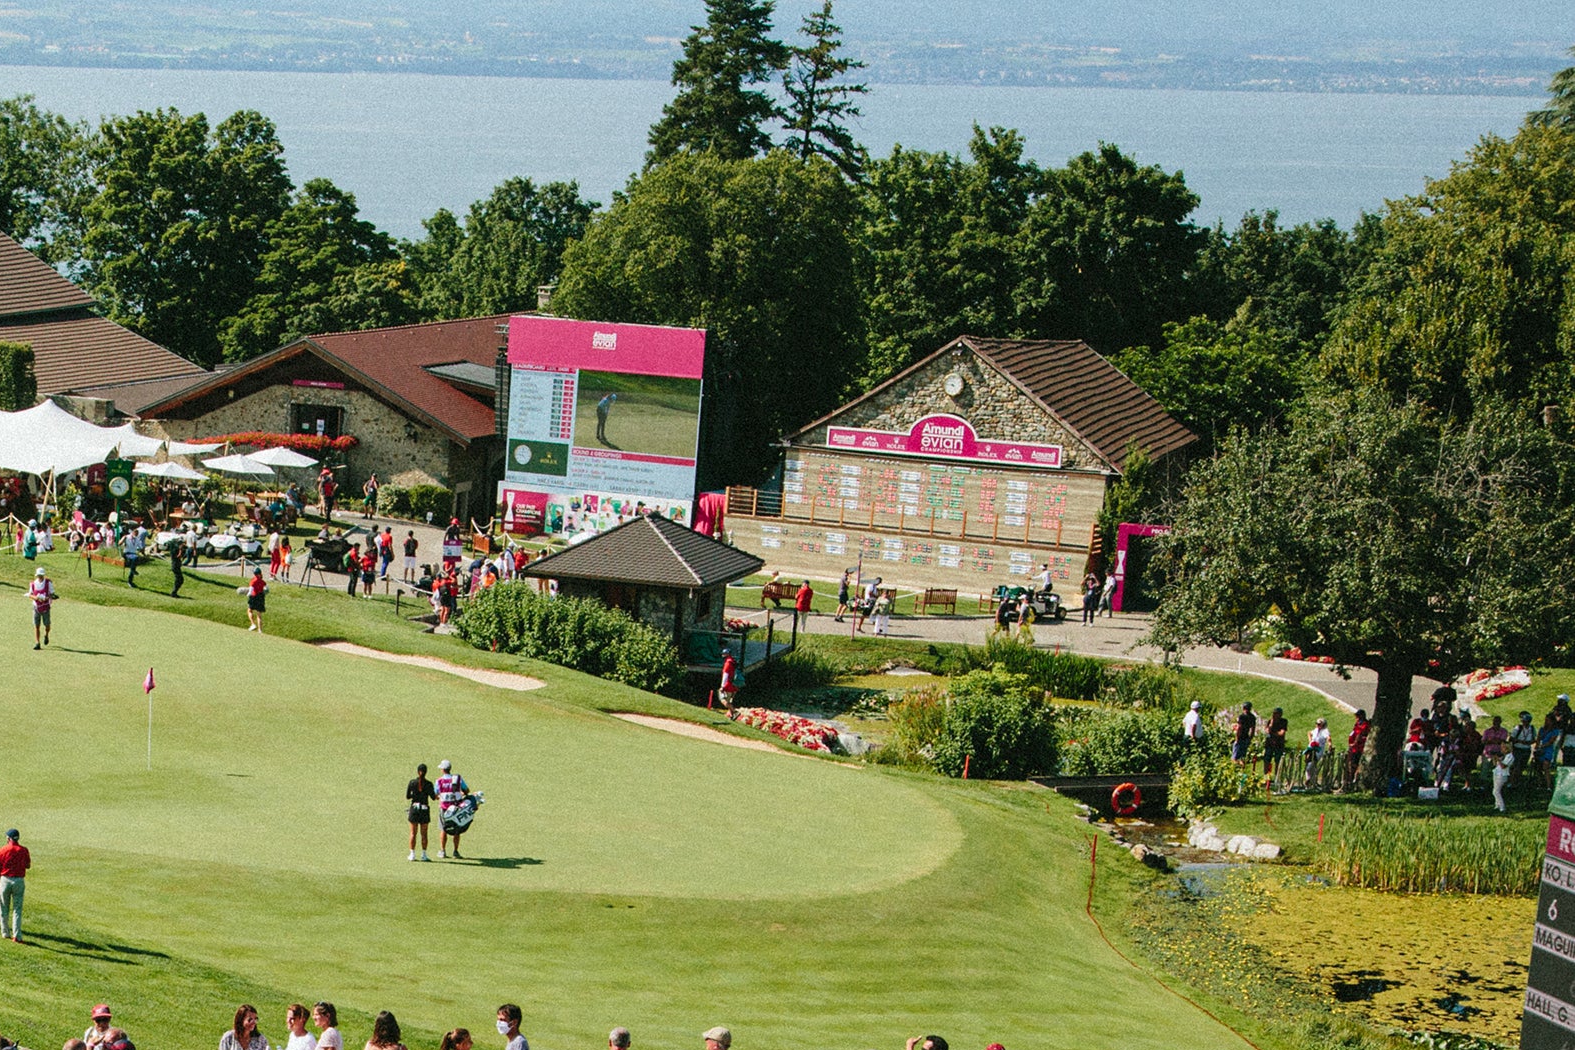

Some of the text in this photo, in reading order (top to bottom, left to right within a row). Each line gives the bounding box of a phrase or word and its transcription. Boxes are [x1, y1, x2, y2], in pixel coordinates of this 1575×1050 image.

[922, 423, 964, 436] Amundi
[862, 440, 879, 448] evian
[921, 437, 963, 450] evian
[920, 446, 963, 455] CHAMPIONSHIP
[1004, 453, 1023, 461] evian
[1545, 862, 1564, 885] KO,
[1548, 899, 1558, 921] 6
[1535, 927, 1575, 959] MAGUI
[1526, 992, 1571, 1026] HALL, G.
